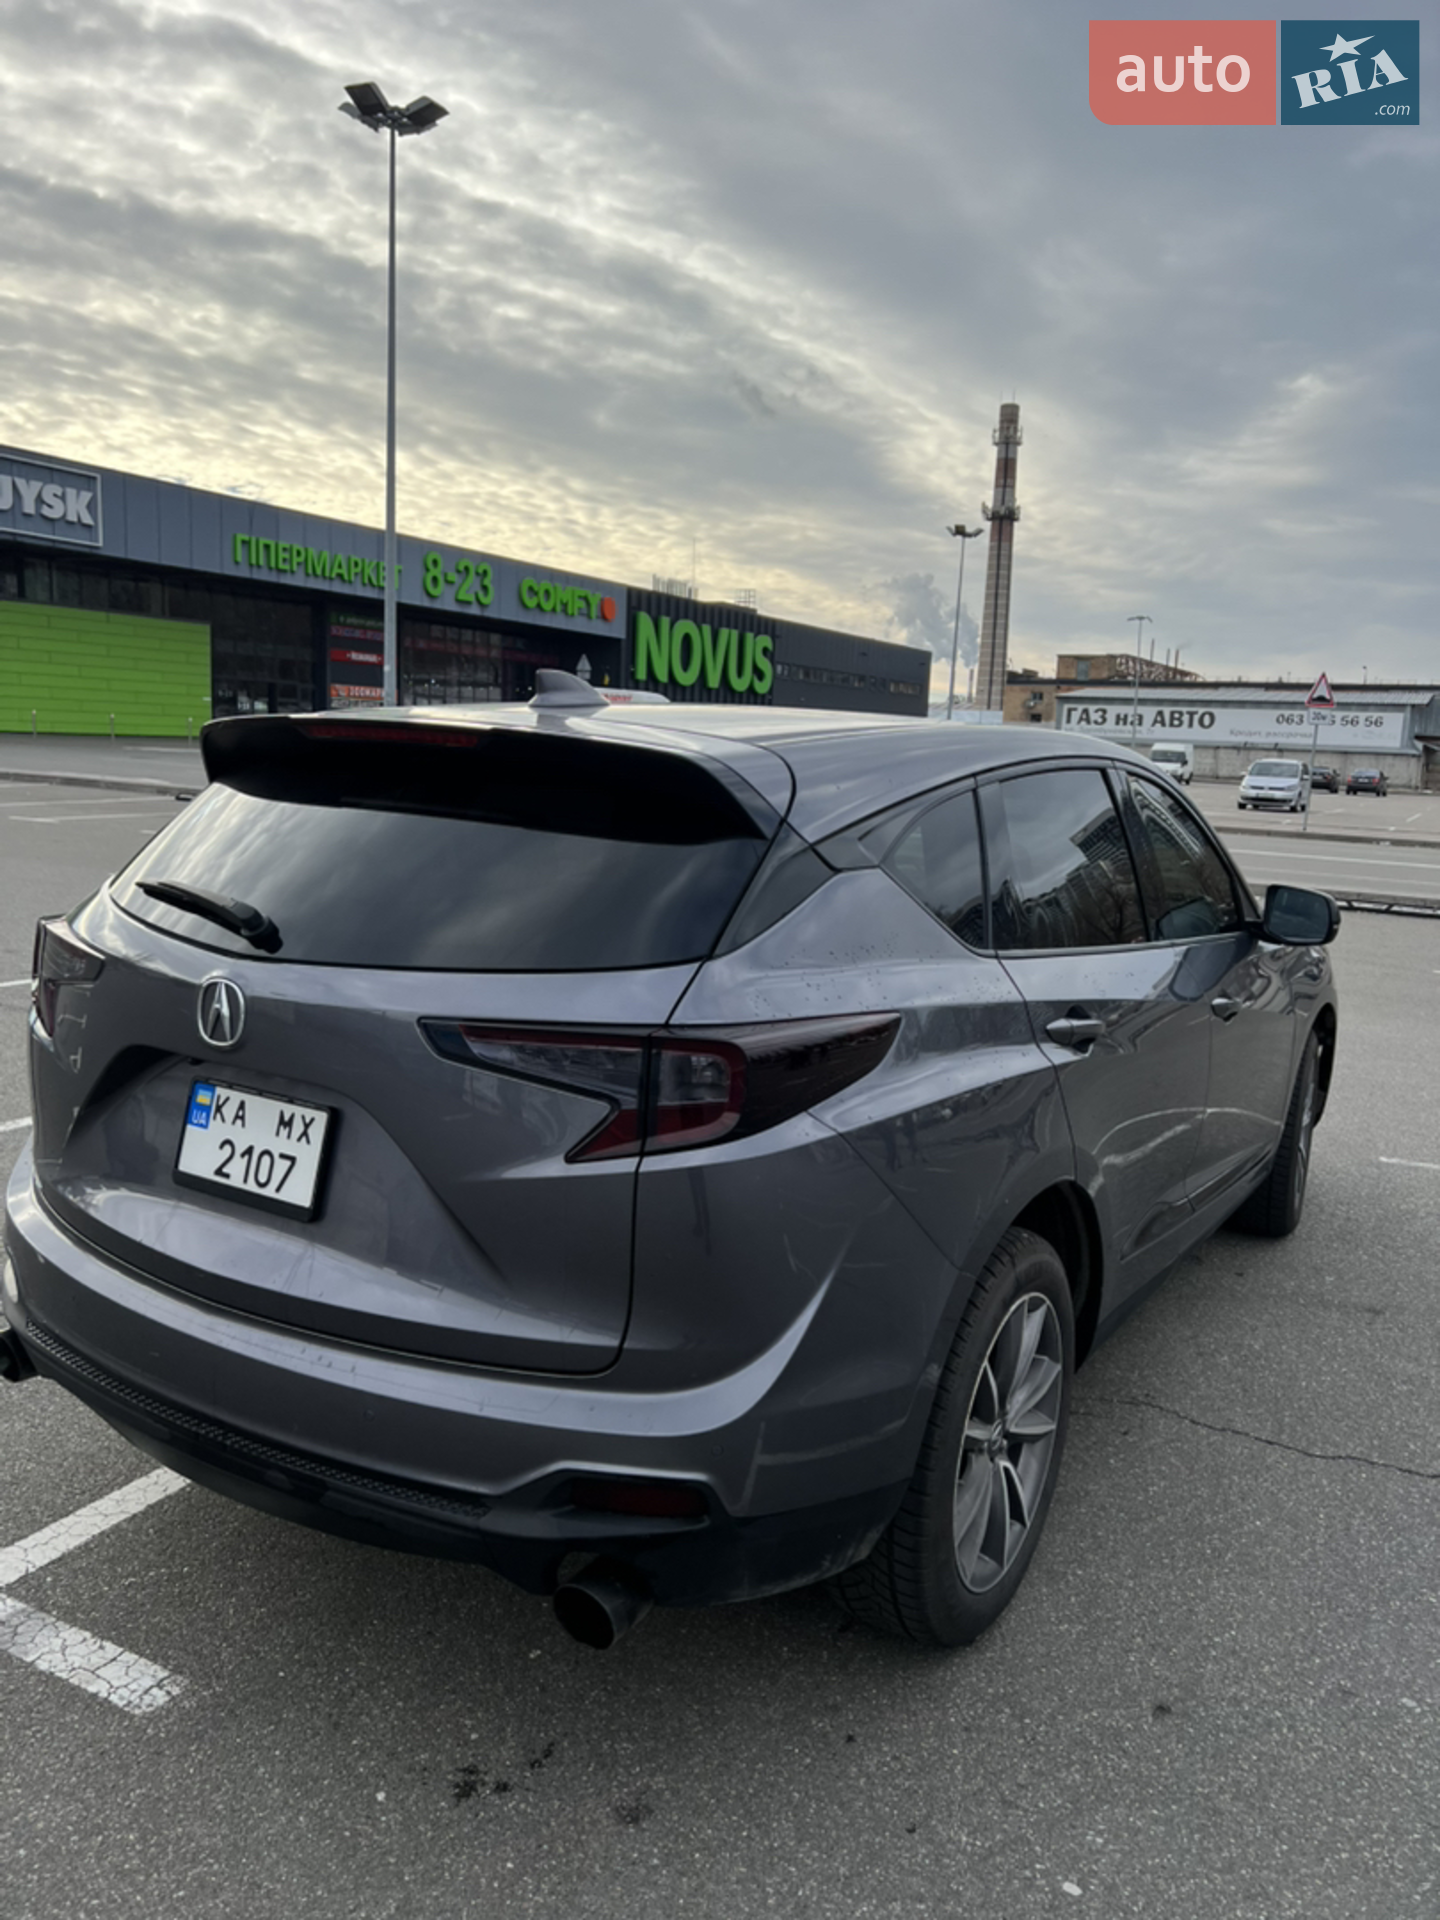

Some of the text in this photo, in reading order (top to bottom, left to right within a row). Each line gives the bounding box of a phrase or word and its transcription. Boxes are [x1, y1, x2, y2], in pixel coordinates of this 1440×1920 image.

[0, 474, 95, 526] JYSK
[423, 551, 494, 606] 8-23
[520, 577, 600, 619] COMFY
[634, 611, 774, 694] NOVUS
[1065, 707, 1216, 729] ГАЗ на АВТО
[1276, 713, 1304, 725] 063
[1340, 715, 1360, 727] 56
[1364, 716, 1384, 728] 56
[192, 1110, 207, 1126] UA
[212, 1094, 315, 1145] KA MX
[213, 1138, 297, 1193] 2107
